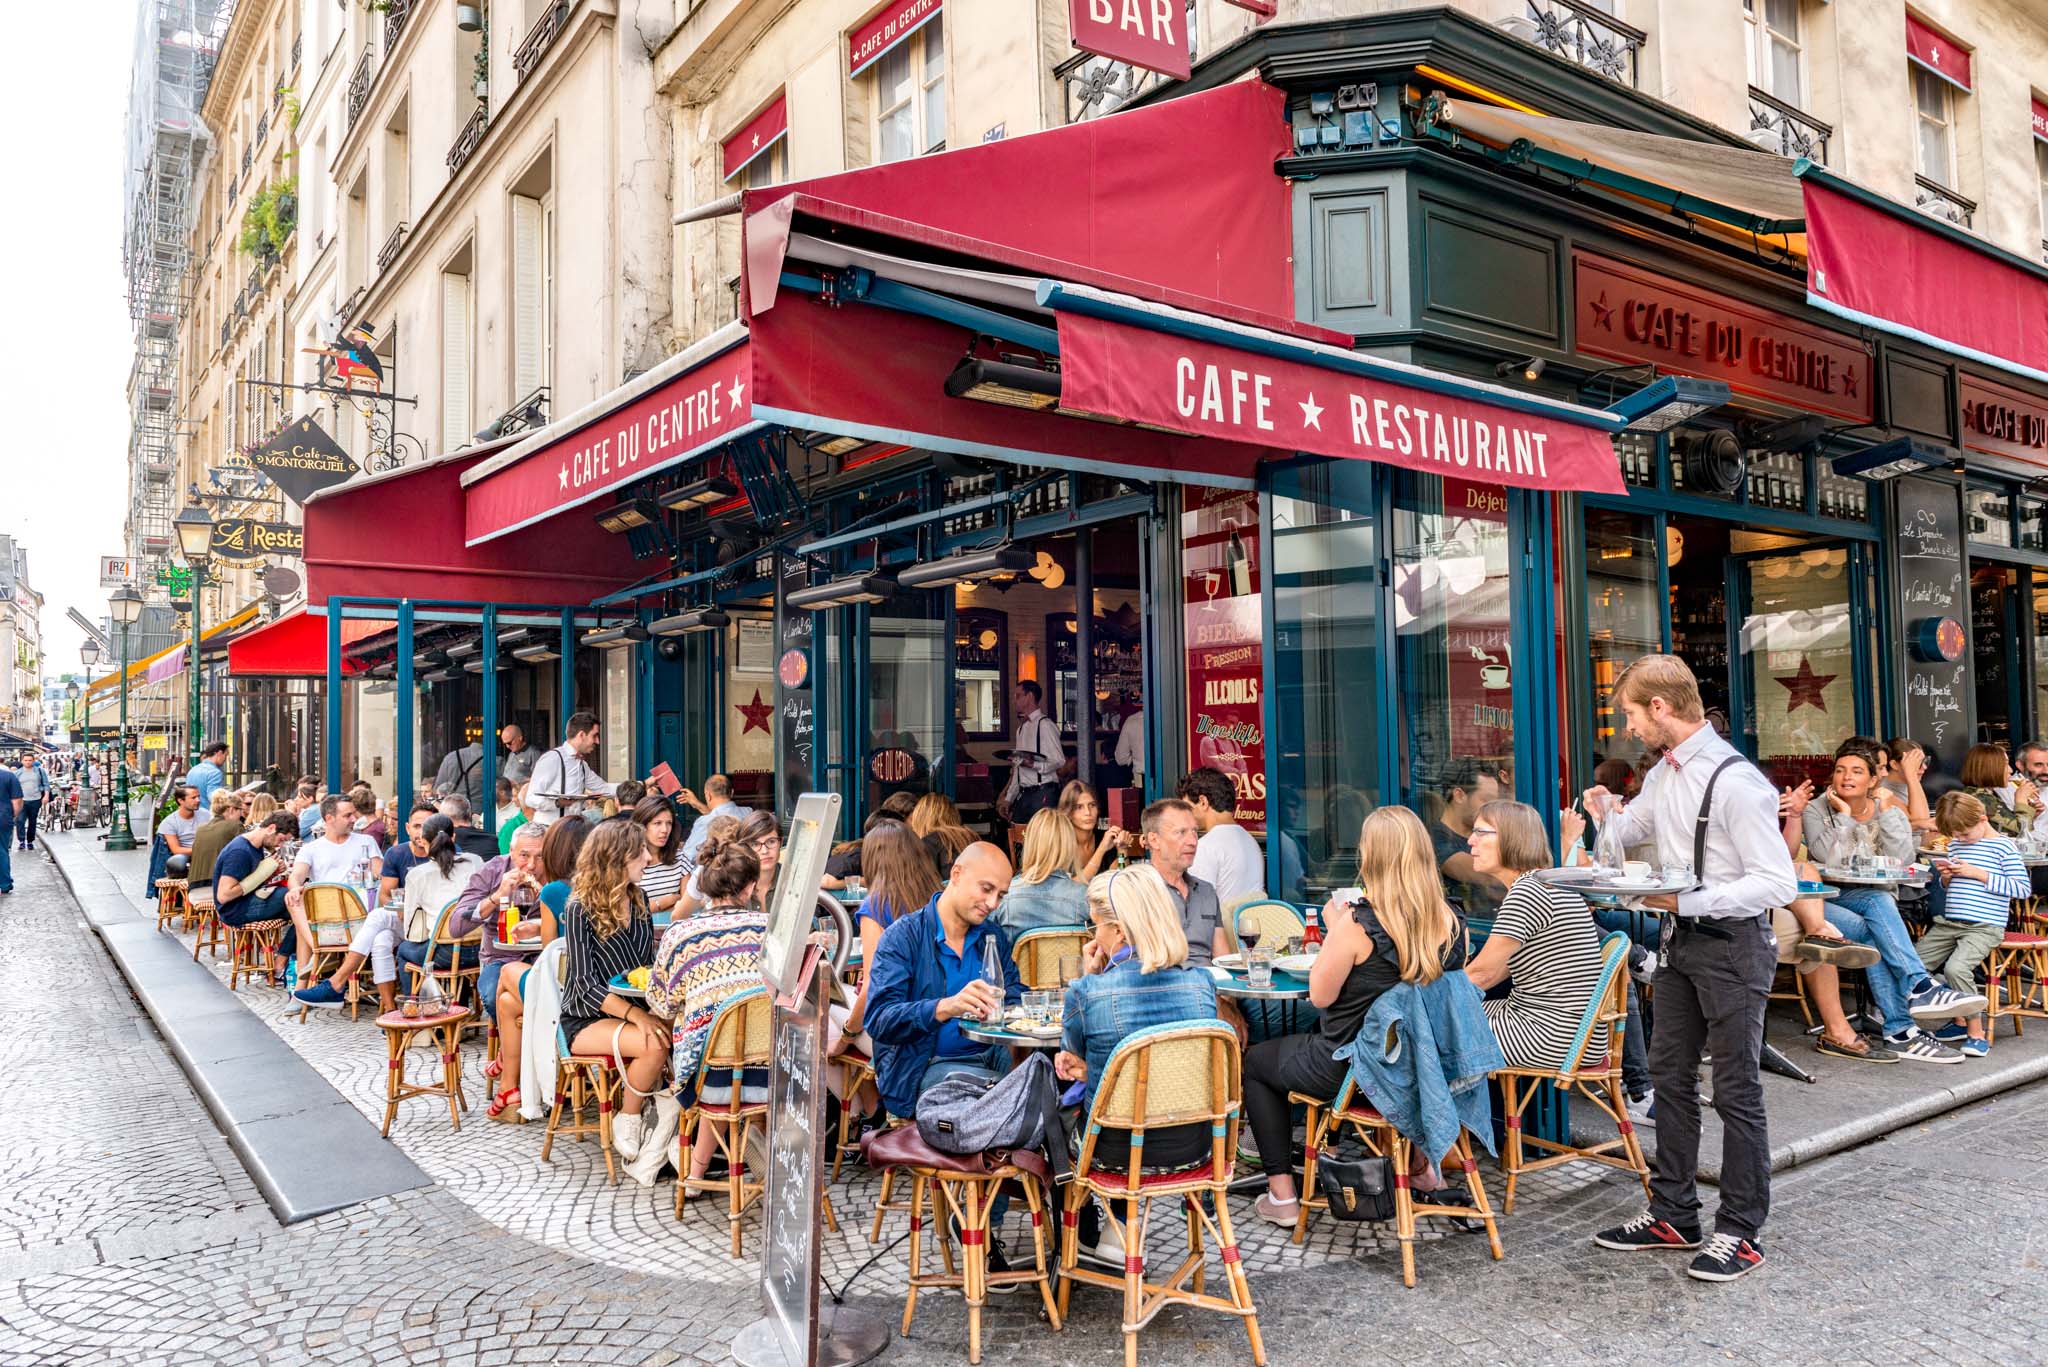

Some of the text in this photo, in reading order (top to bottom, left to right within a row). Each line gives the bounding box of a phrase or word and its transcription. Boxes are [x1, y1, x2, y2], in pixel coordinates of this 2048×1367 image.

[861, 31, 882, 57] CAFE
[884, 19, 896, 40] DU
[1089, 0, 1175, 46] BAR
[1625, 300, 1837, 392] CAFE DU CENTRE
[573, 381, 722, 488] CAFE DU CENTRE
[1176, 357, 1548, 478] CAFE RESTAURANT
[1978, 403, 2048, 447] CAFE DU
[265, 456, 346, 472] MONTORGUEIL
[293, 446, 320, 459] Café
[1205, 678, 1258, 706] ALCOOLS
[1195, 713, 1261, 747] Digestifs
[1234, 804, 1265, 820] heure
